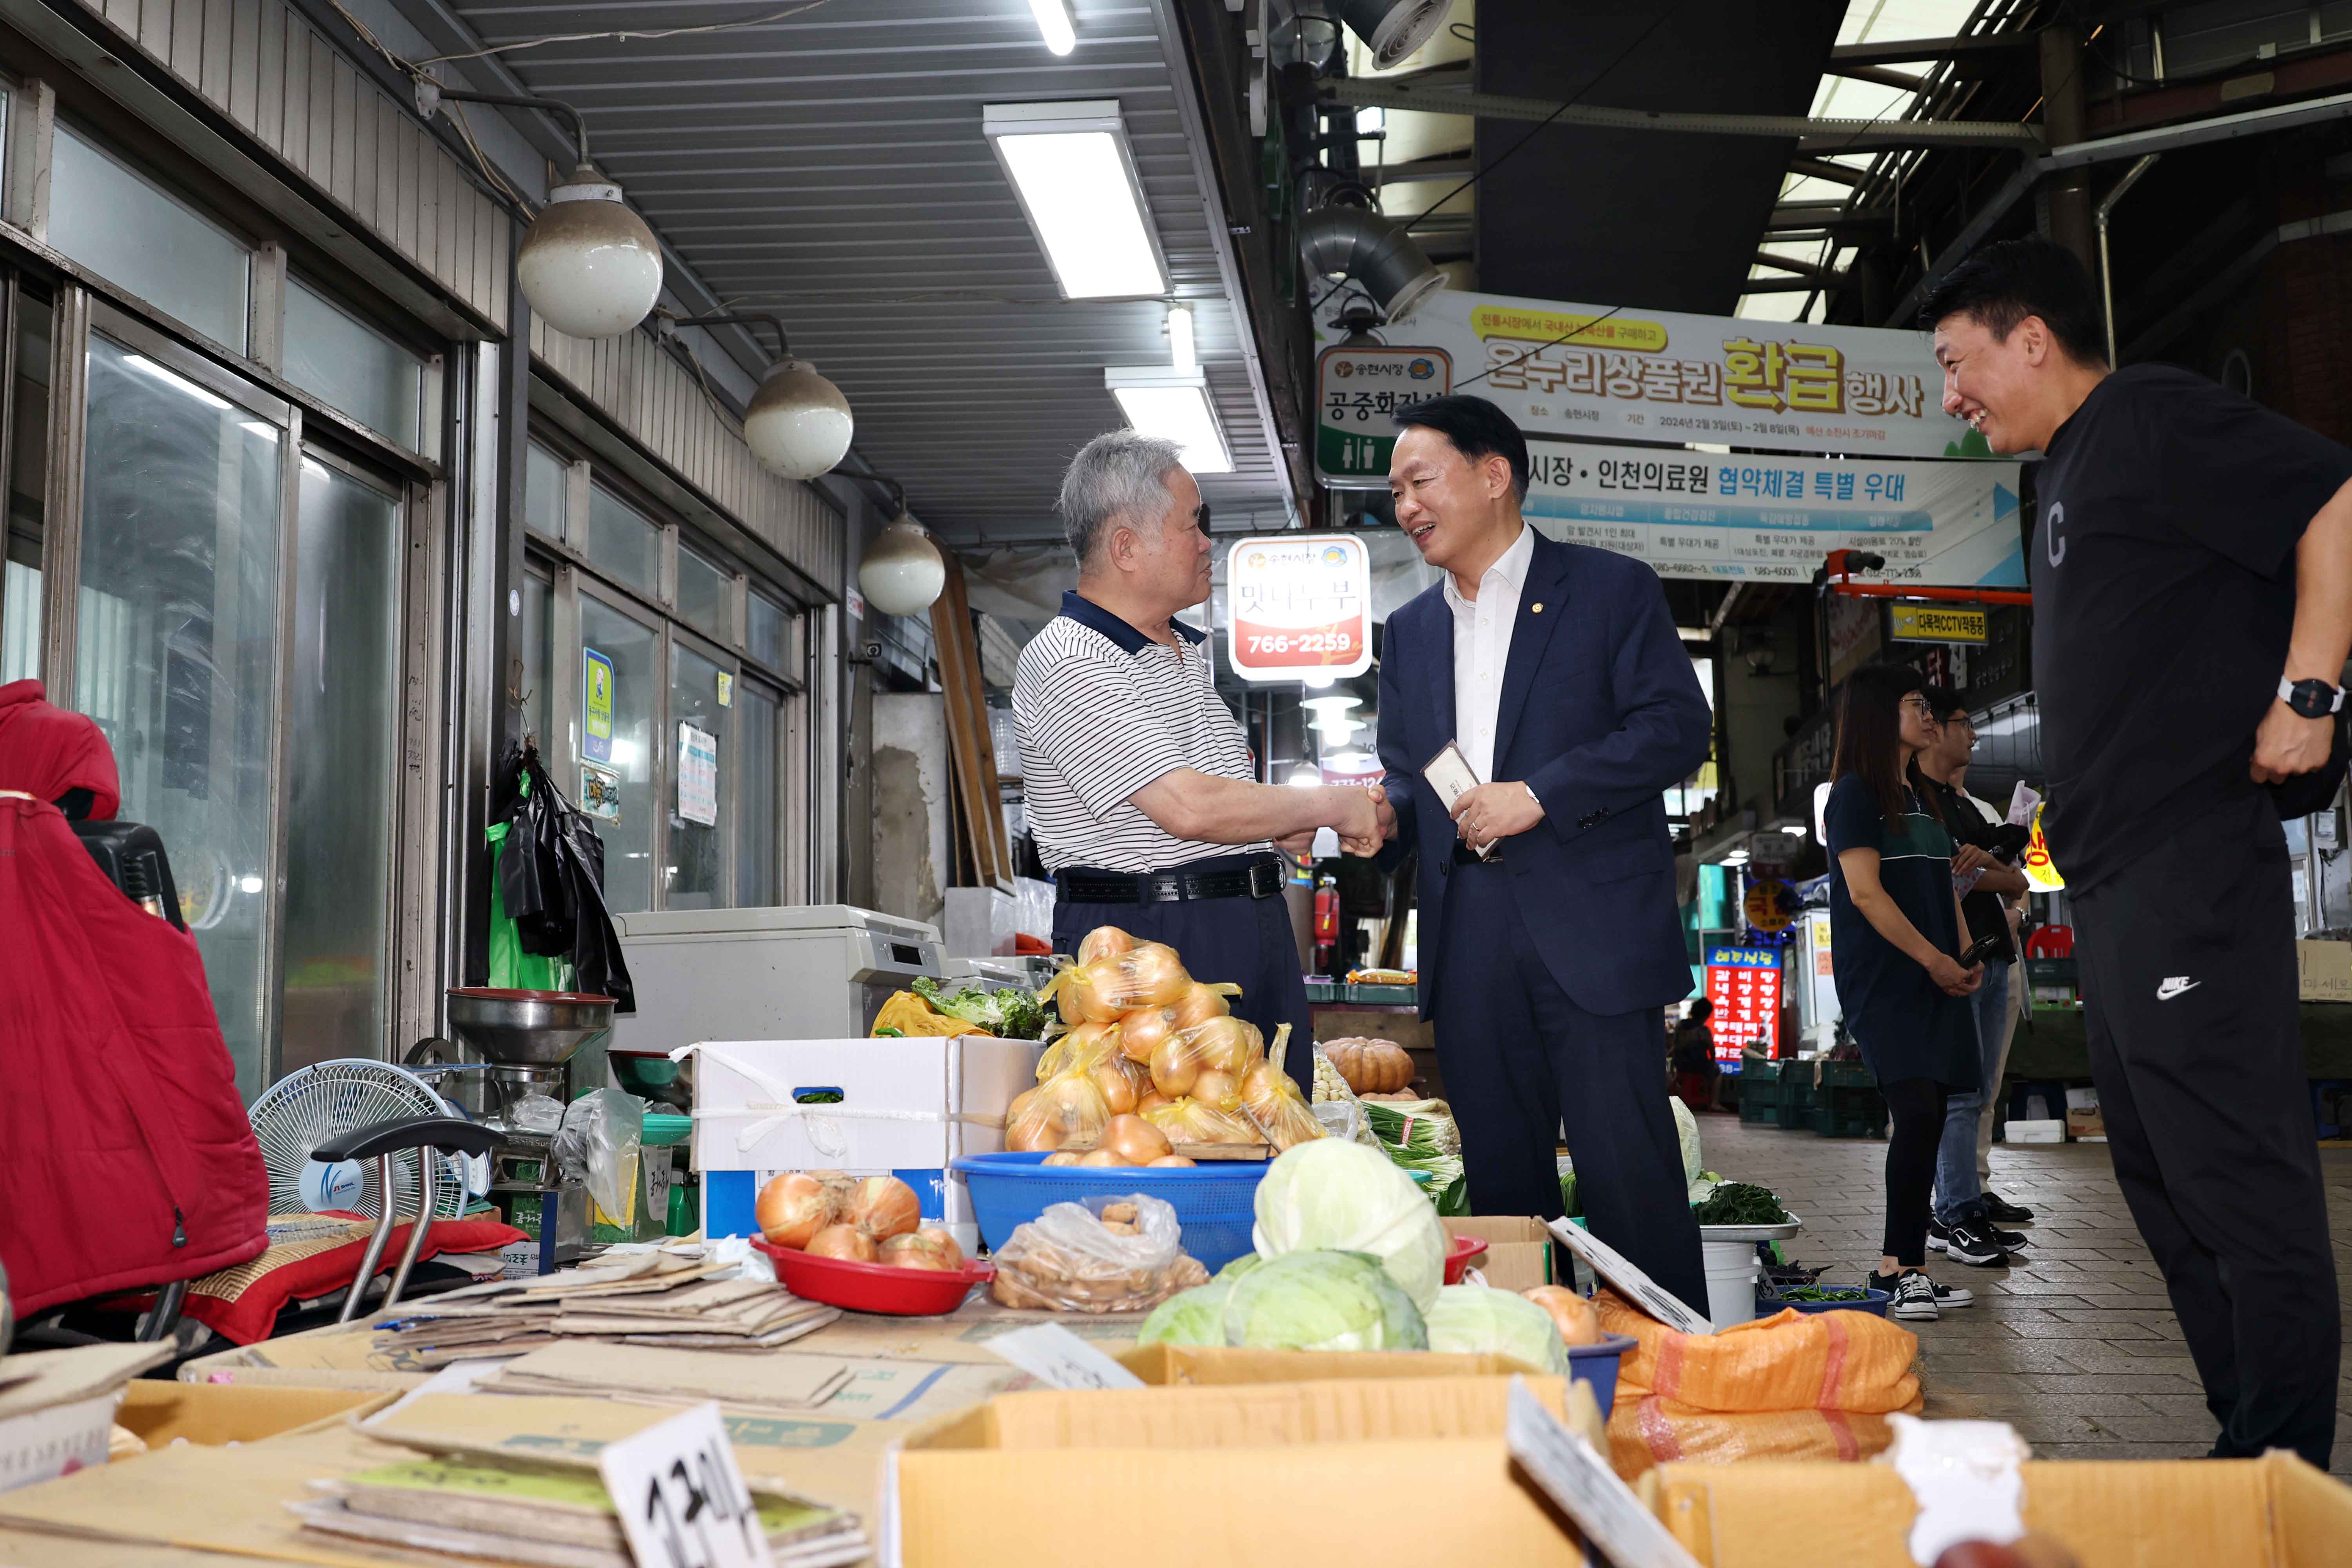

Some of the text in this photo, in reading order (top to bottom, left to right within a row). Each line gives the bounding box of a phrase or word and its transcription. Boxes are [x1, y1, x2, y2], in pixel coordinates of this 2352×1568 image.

[1482, 314, 1541, 330] 전통시장에서
[1544, 319, 1574, 332] 국내산
[1619, 327, 1656, 340] 구매하고
[1356, 364, 1403, 376] 송현시장
[1485, 336, 1925, 419] 온누리상품권 환급 행사
[1531, 405, 1548, 416] 장소
[1564, 408, 1599, 421] 송현시장
[1627, 414, 1644, 424] 기간
[1661, 417, 1693, 428] 2024년
[1695, 419, 1710, 429] 2월
[1713, 420, 1742, 432] 3일(토)
[1753, 423, 1767, 433] 2월
[1770, 424, 1799, 436] 8일(목)
[1853, 429, 1885, 441] 조기마감
[1599, 460, 1708, 494] 인천의료원
[1719, 467, 1804, 498] 협약체결
[1815, 472, 1855, 500] 특별
[1864, 474, 1905, 502] 우대
[1889, 537, 1906, 546] 20%
[2047, 501, 2066, 568] C
[1269, 554, 1316, 566] 송현시장
[1919, 613, 1984, 635] 다목적CCTV작동중
[1248, 633, 1350, 653] 766-2259
[2161, 976, 2190, 991] NIKE
